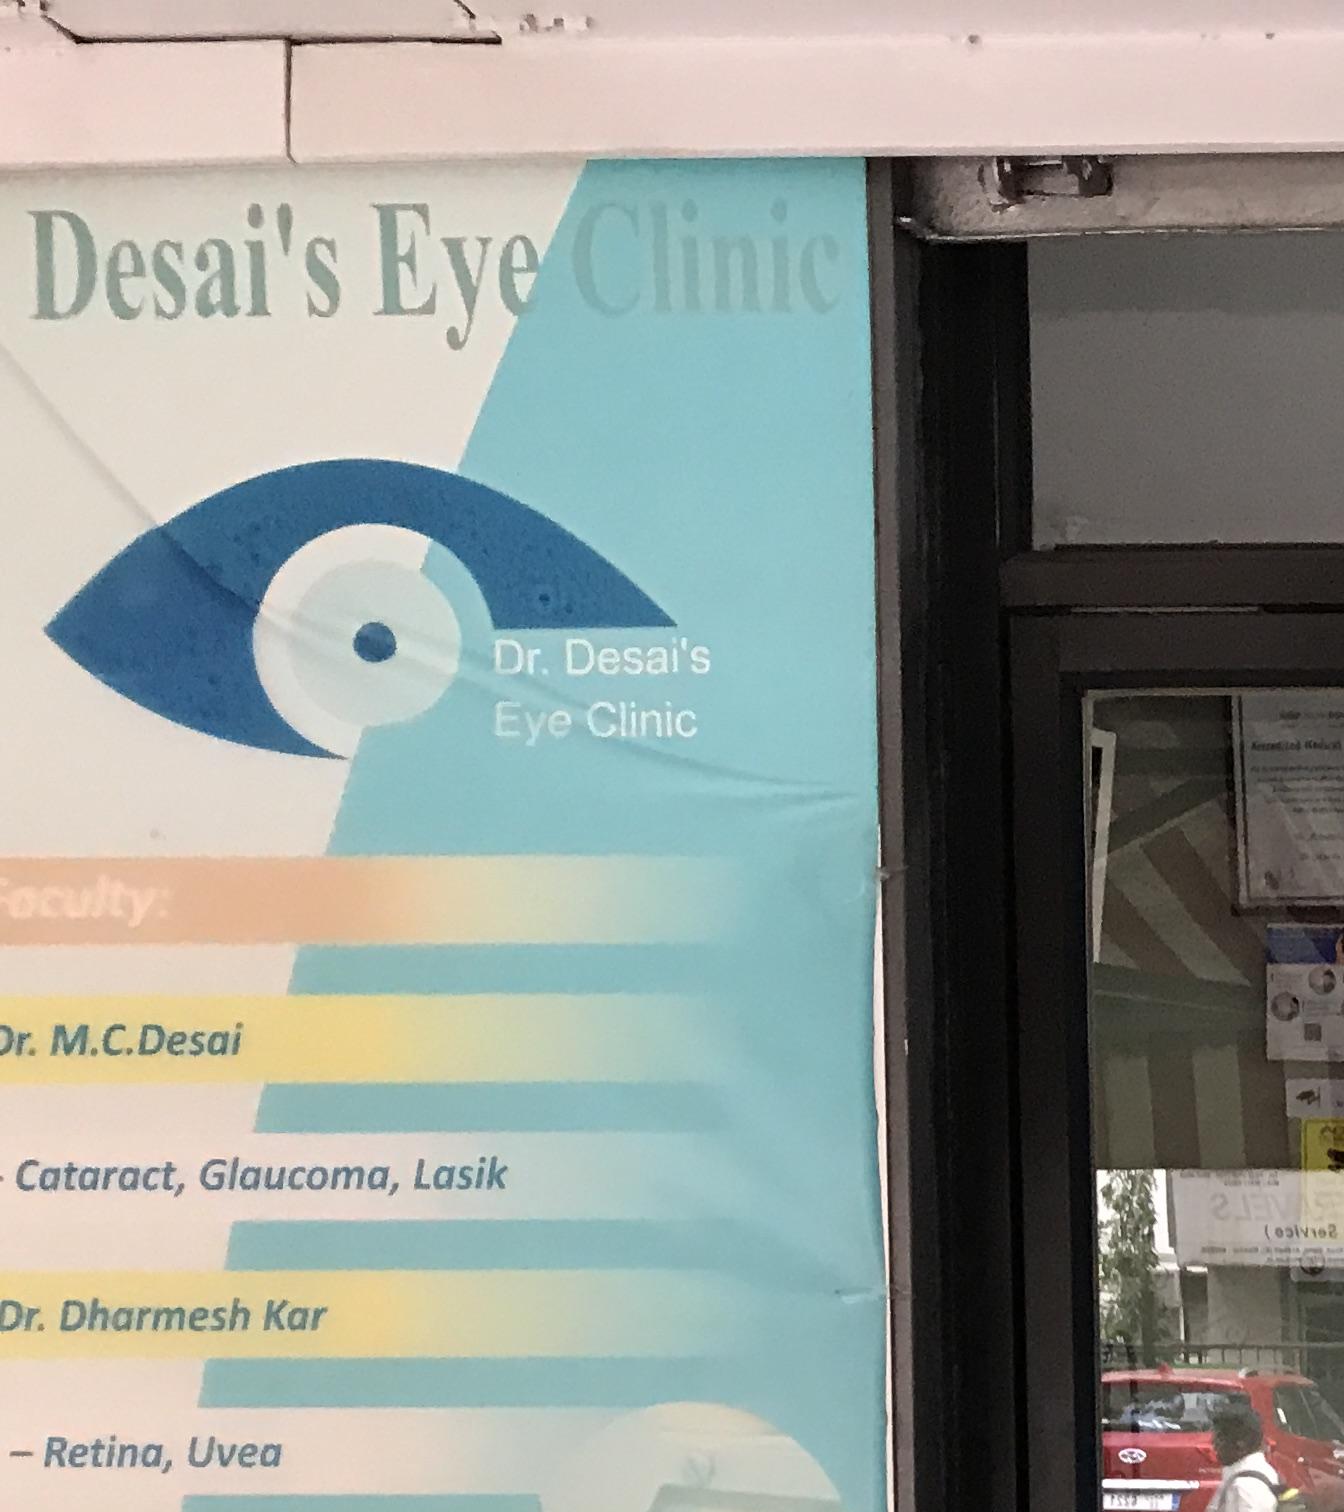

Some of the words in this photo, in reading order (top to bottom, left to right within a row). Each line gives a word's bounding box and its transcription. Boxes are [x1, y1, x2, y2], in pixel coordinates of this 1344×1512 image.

[28, 203, 341, 322] Desai's
[371, 202, 541, 350] Eye
[570, 200, 843, 319] Clinic
[494, 640, 549, 676] Dr.
[566, 638, 711, 677] Desai's
[495, 703, 572, 741] Eye
[586, 701, 698, 739] Clinic
[0, 1024, 36, 1057] Dr.
[50, 1022, 243, 1057] M.C.Desai
[16, 1158, 186, 1198] Cataract,
[199, 1157, 401, 1197] Glaucoma,
[413, 1156, 508, 1192] Lasik
[0, 1299, 45, 1332] Dr.
[59, 1298, 250, 1333] Dharmesh
[263, 1299, 328, 1333] Kar
[43, 1435, 174, 1475] Retina,
[187, 1435, 283, 1469] Uvea
